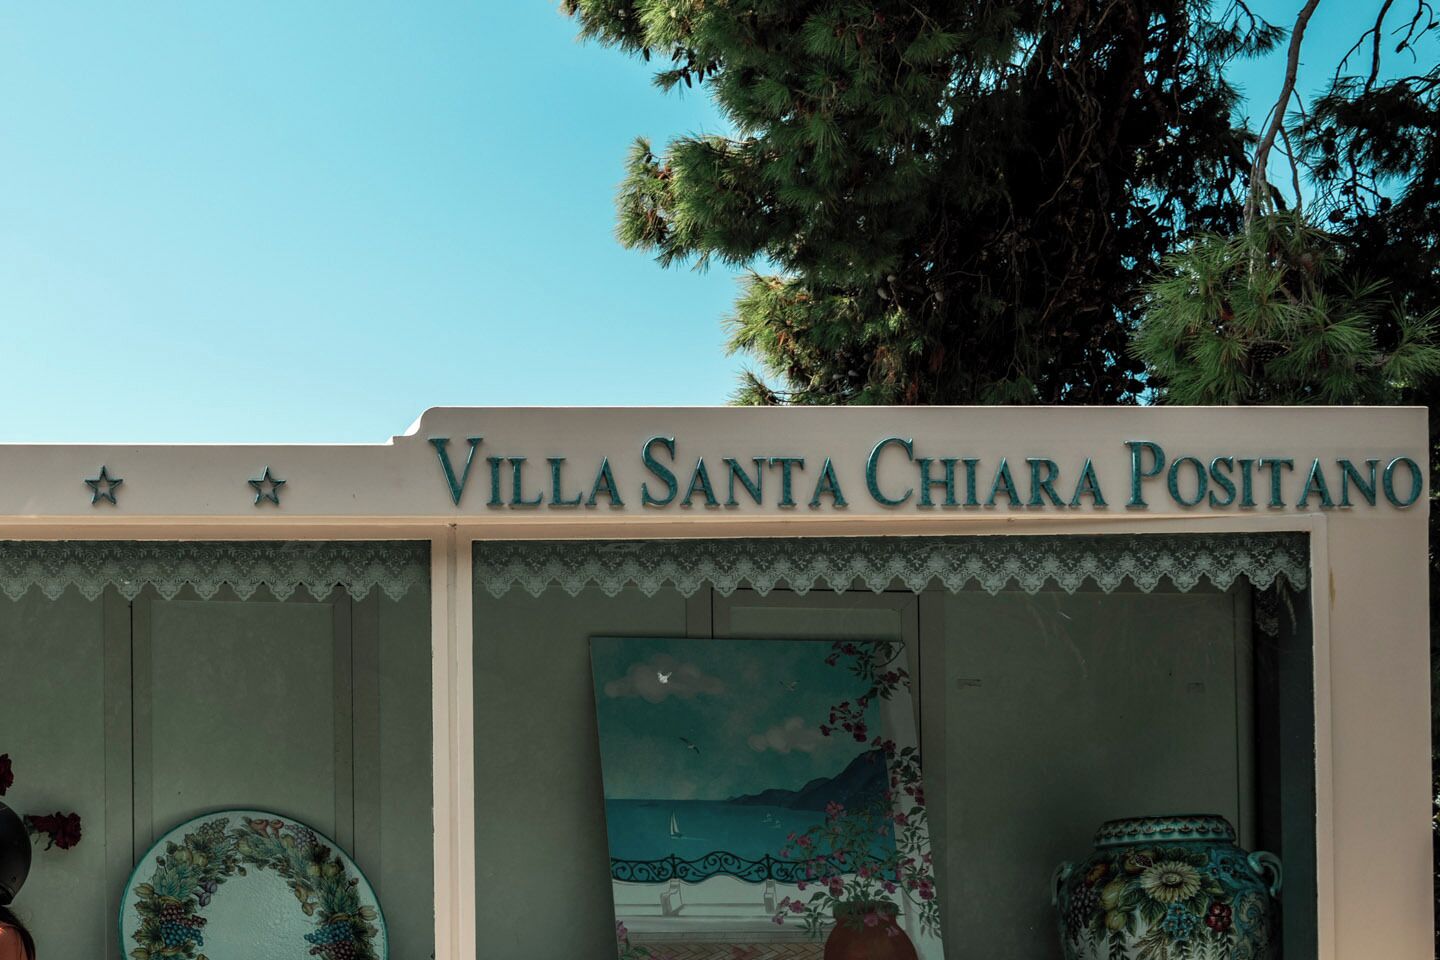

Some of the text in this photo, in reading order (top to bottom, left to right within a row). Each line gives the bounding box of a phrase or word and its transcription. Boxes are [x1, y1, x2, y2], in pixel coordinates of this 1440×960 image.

[428, 435, 1424, 509] VILLA SANTA CHIARA POSITANO
